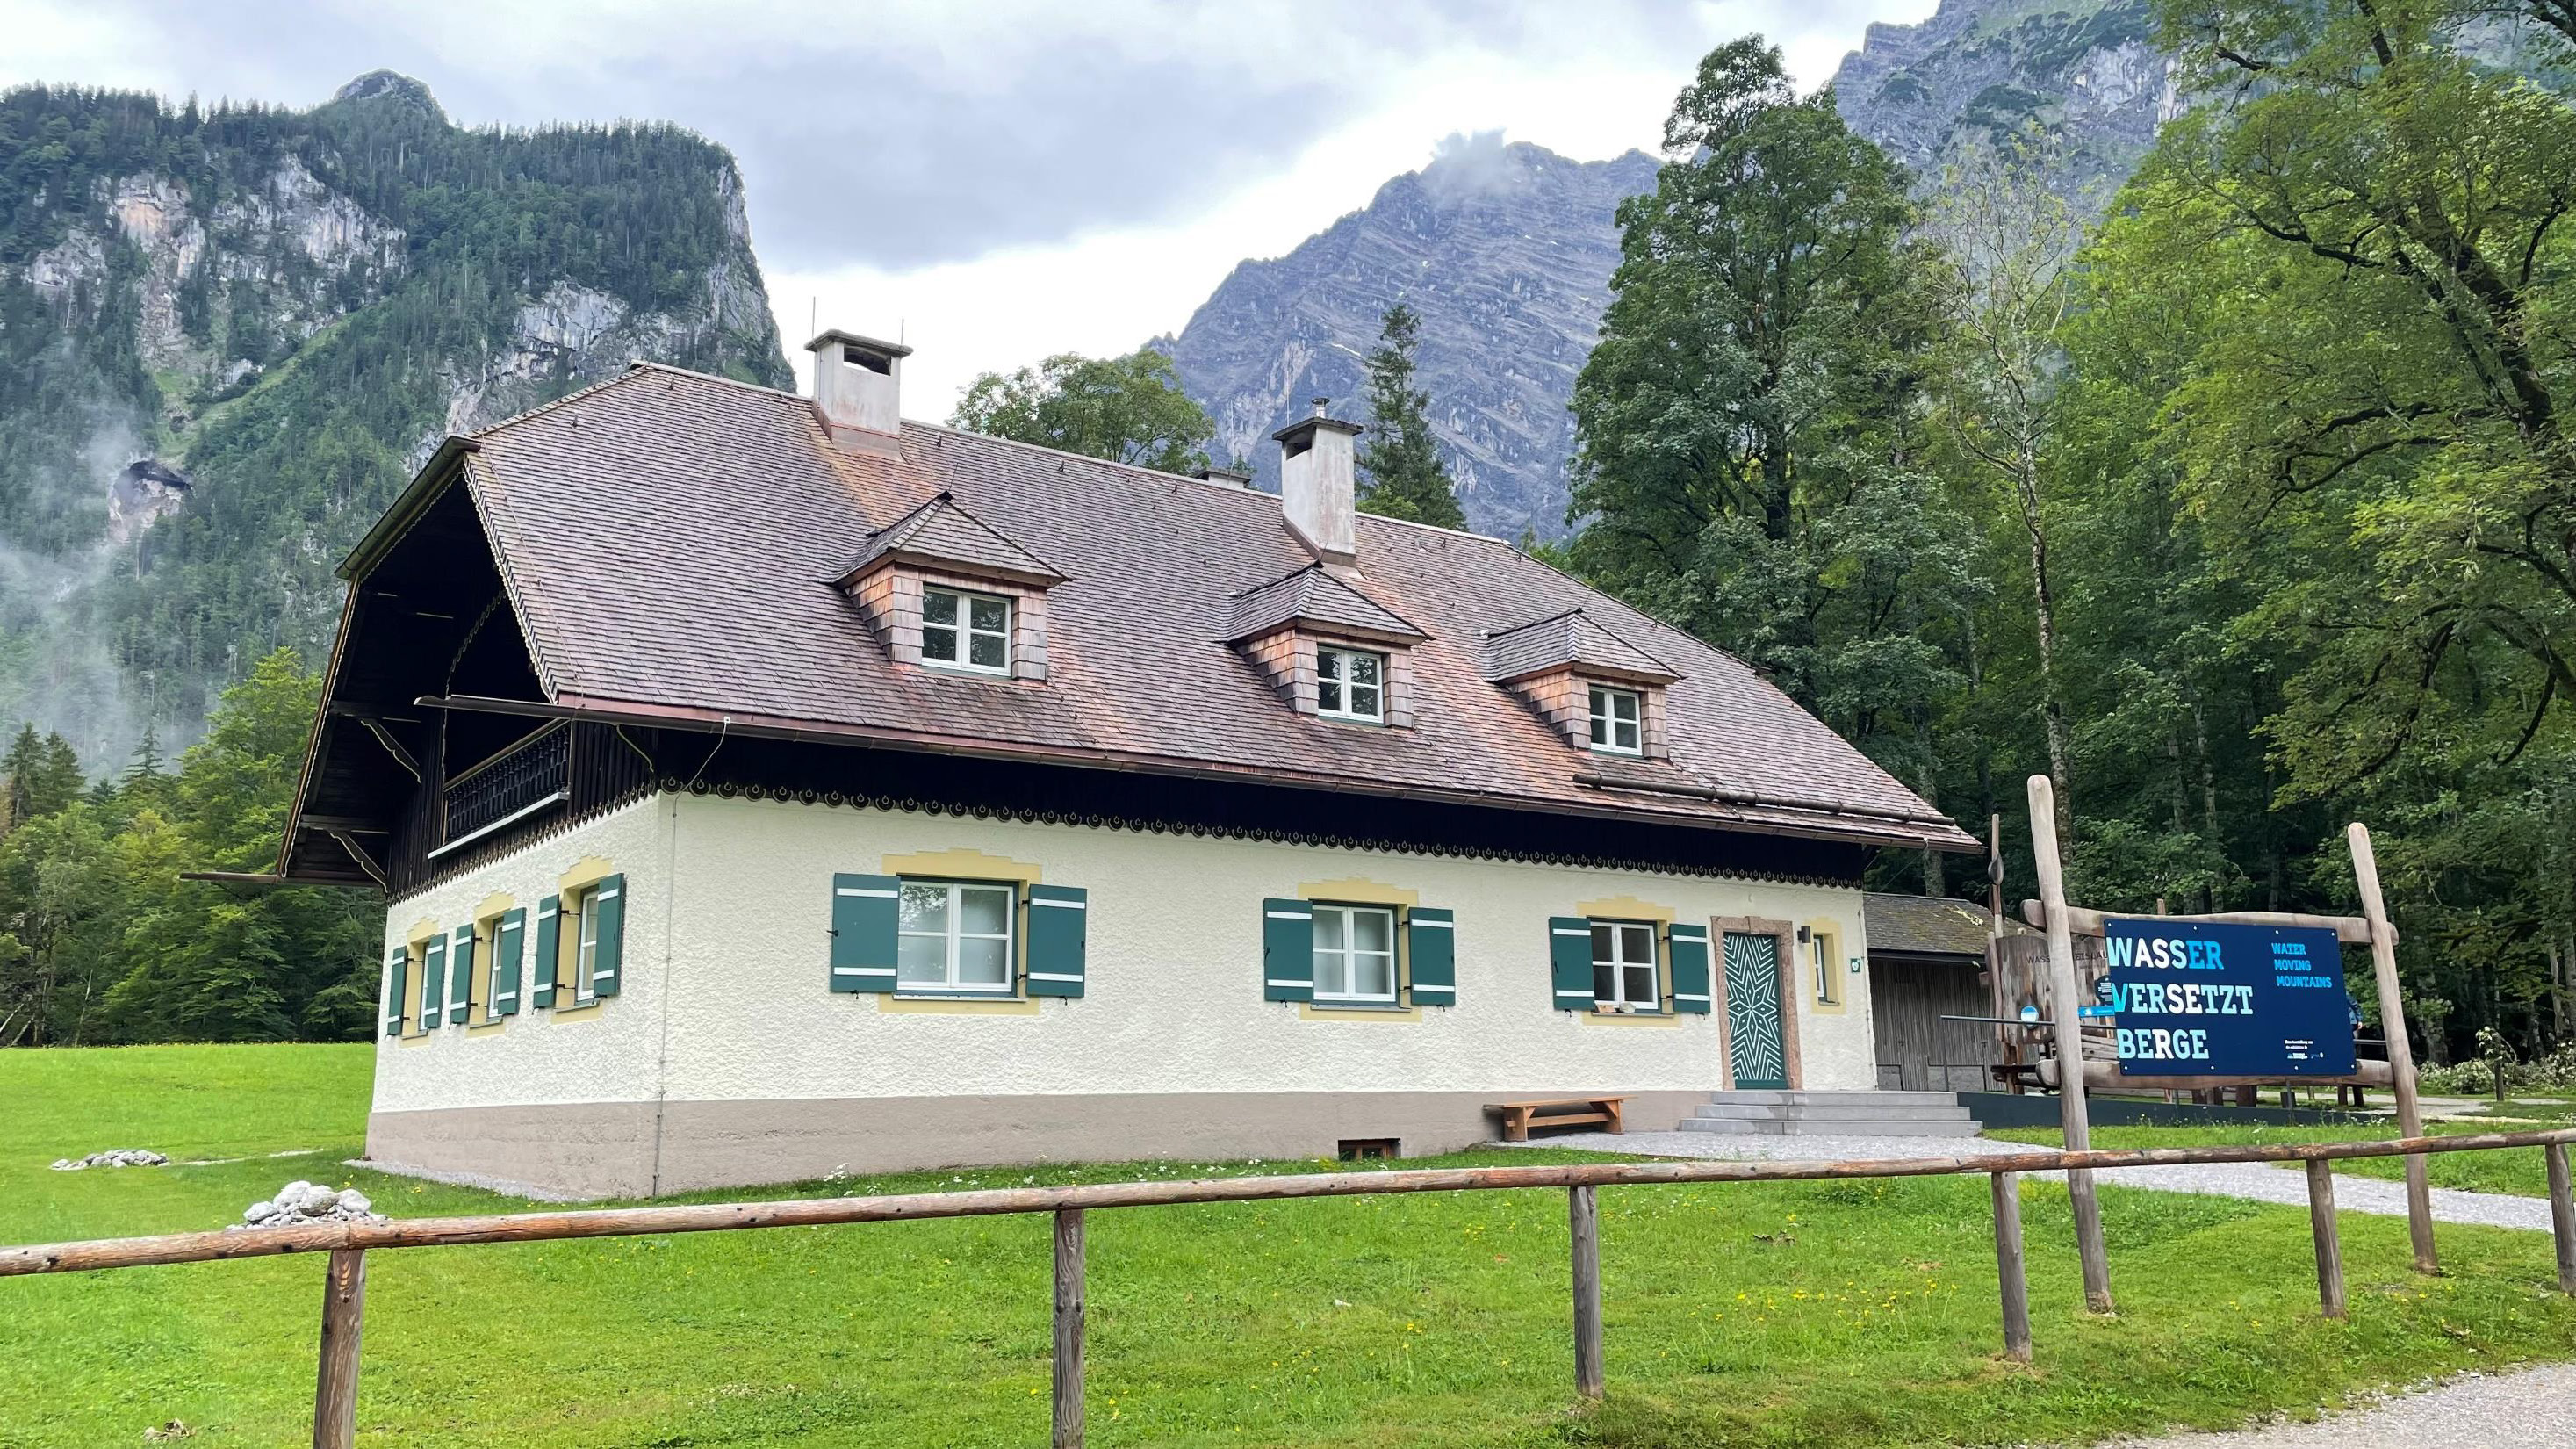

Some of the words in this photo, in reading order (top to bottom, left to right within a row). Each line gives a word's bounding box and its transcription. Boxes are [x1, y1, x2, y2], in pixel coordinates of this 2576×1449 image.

[2106, 937, 2224, 970] WASSER
[2271, 943, 2306, 955] WATER
[2274, 959, 2312, 971] MOVING
[2276, 976, 2333, 988] MOUNTAINS
[2112, 983, 2254, 1015] VERSETZT
[2116, 1028, 2210, 1060] BERGE
